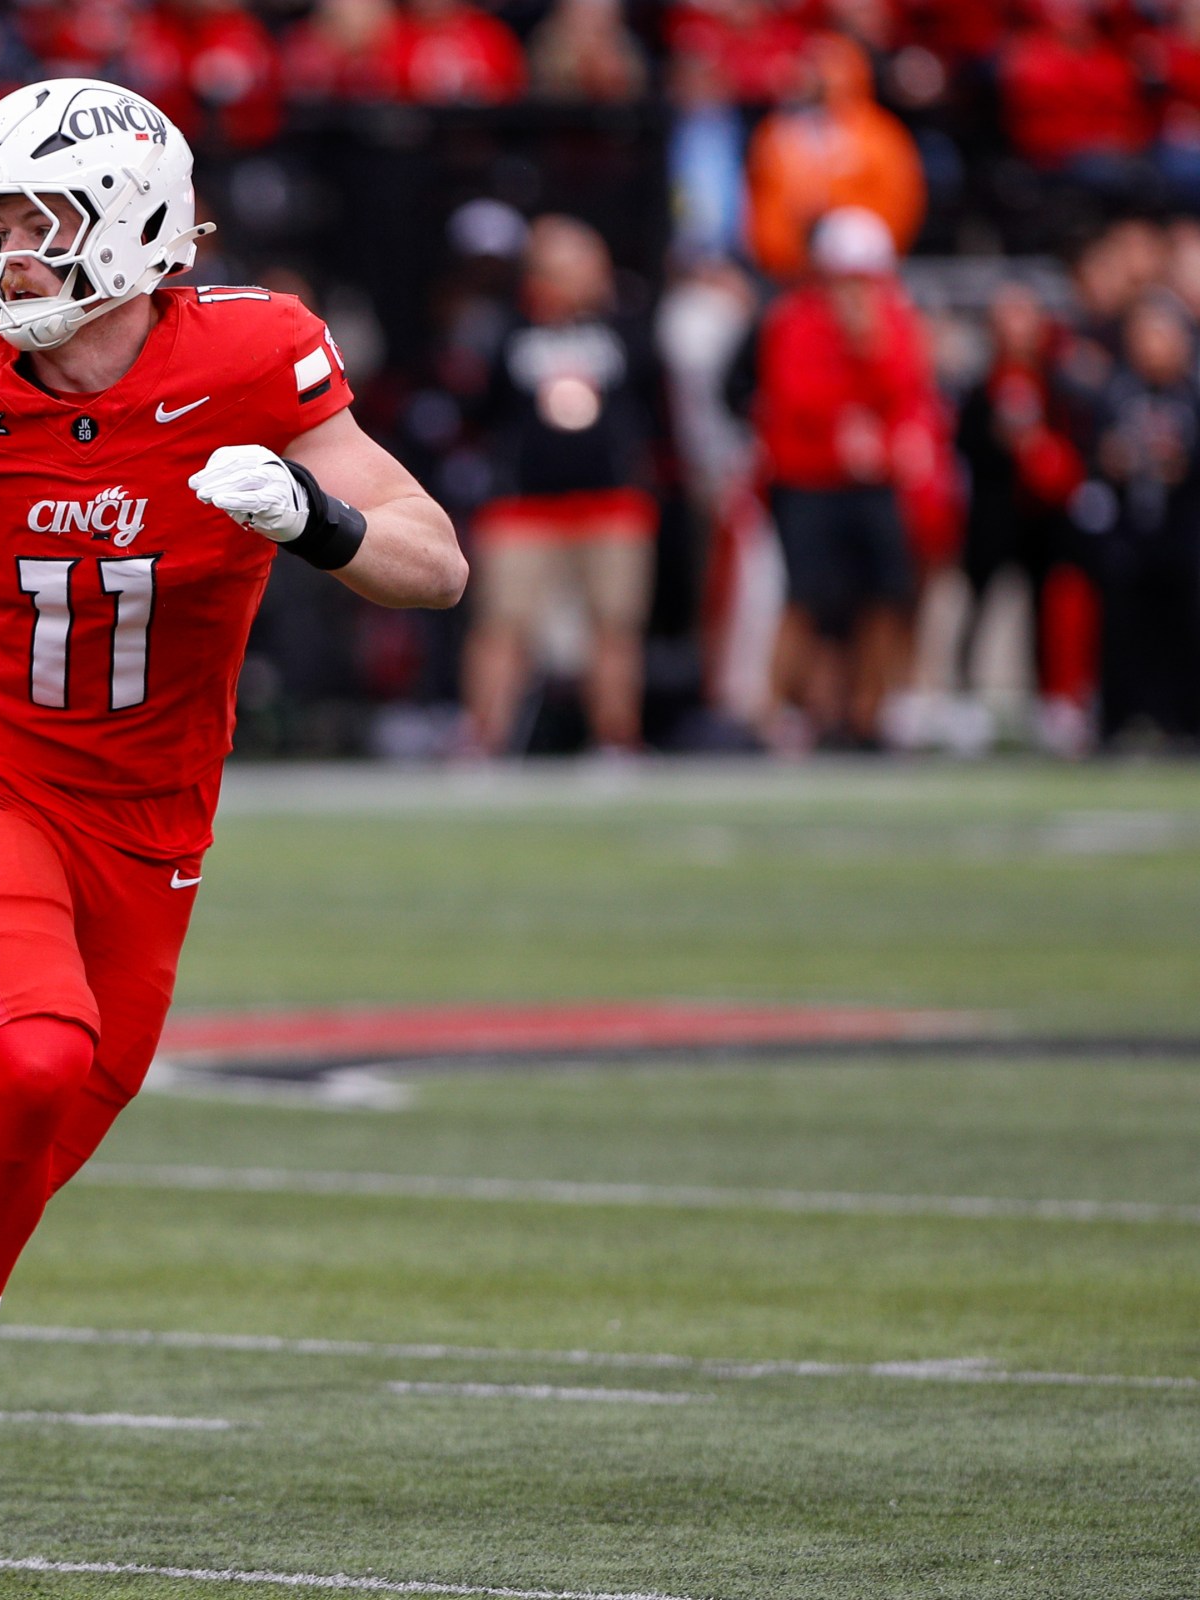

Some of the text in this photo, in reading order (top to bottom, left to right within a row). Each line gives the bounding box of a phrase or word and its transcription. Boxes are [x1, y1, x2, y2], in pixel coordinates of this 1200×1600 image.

[69, 97, 167, 146] CINCY
[78, 419, 90, 429] JK
[79, 430, 91, 440] 58
[27, 485, 149, 547] CINCY
[16, 554, 162, 712] 11
